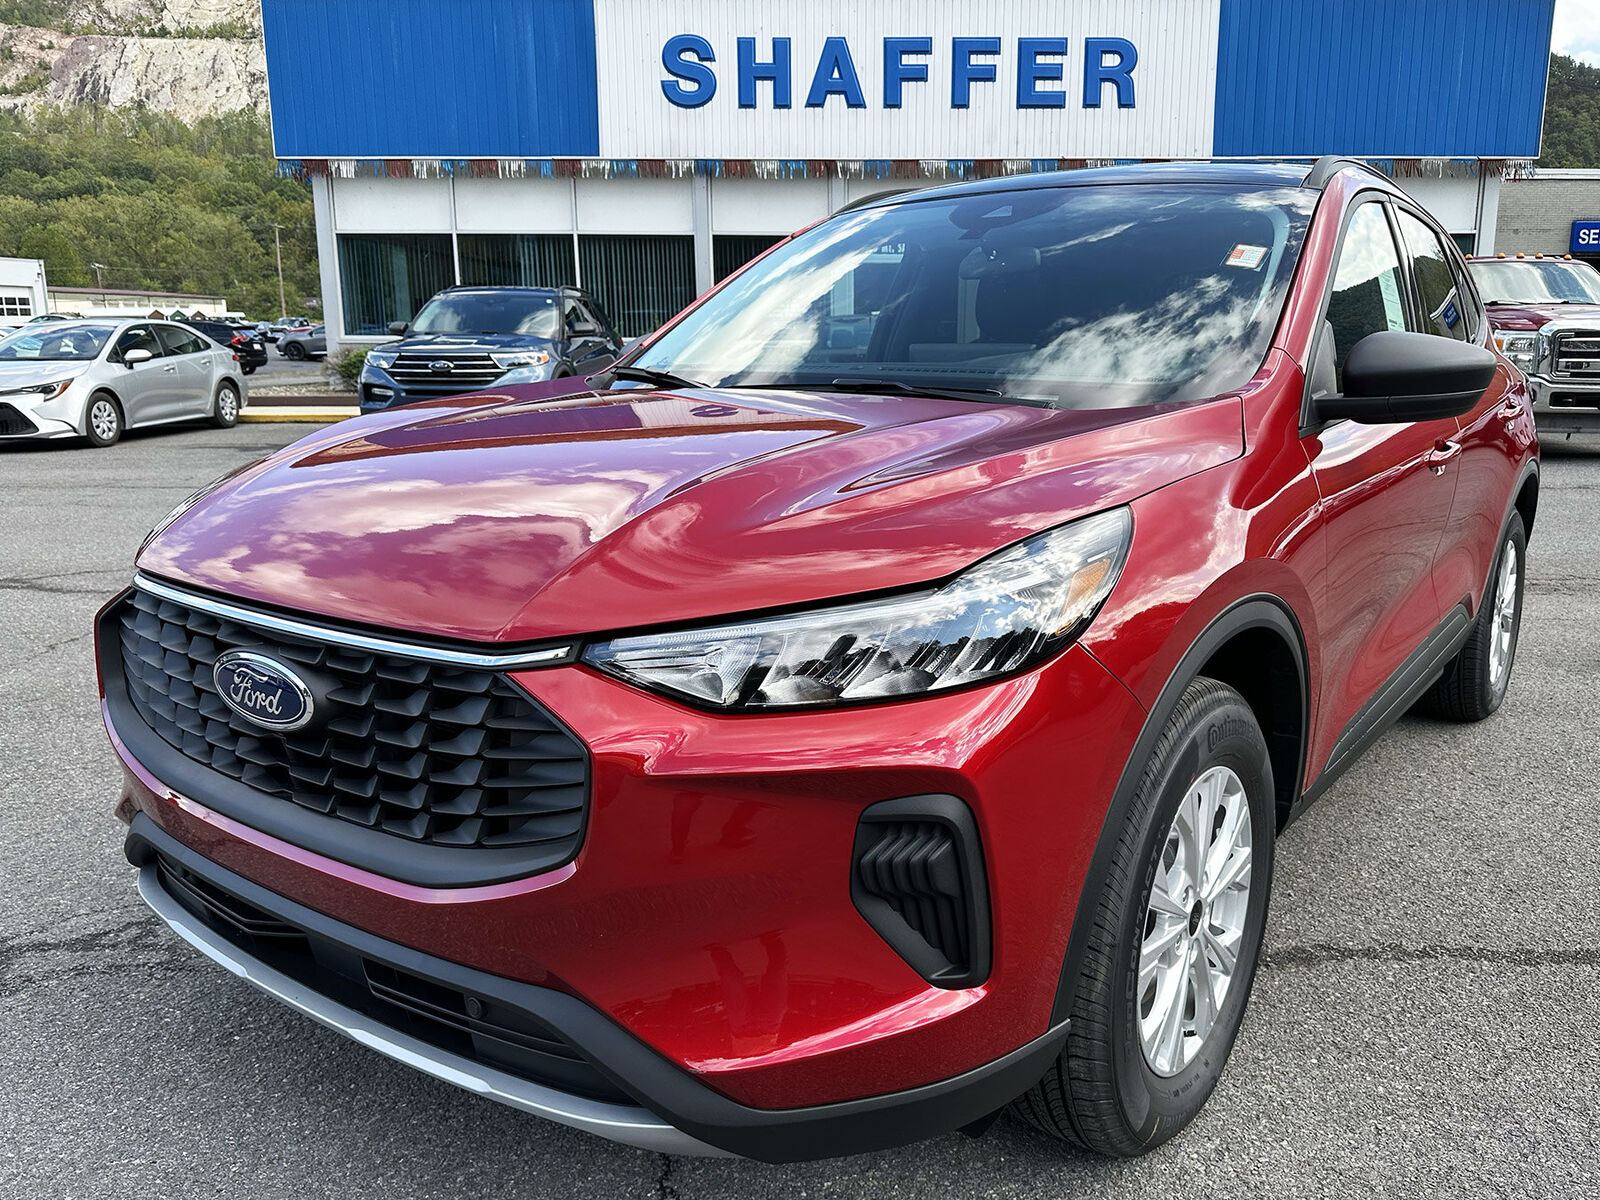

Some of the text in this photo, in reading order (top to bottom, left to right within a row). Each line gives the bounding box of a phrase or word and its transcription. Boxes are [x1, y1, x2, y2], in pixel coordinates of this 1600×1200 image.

[661, 34, 1138, 109] SHAFFER
[1578, 229, 1600, 244] SE
[230, 667, 282, 715] Ford
